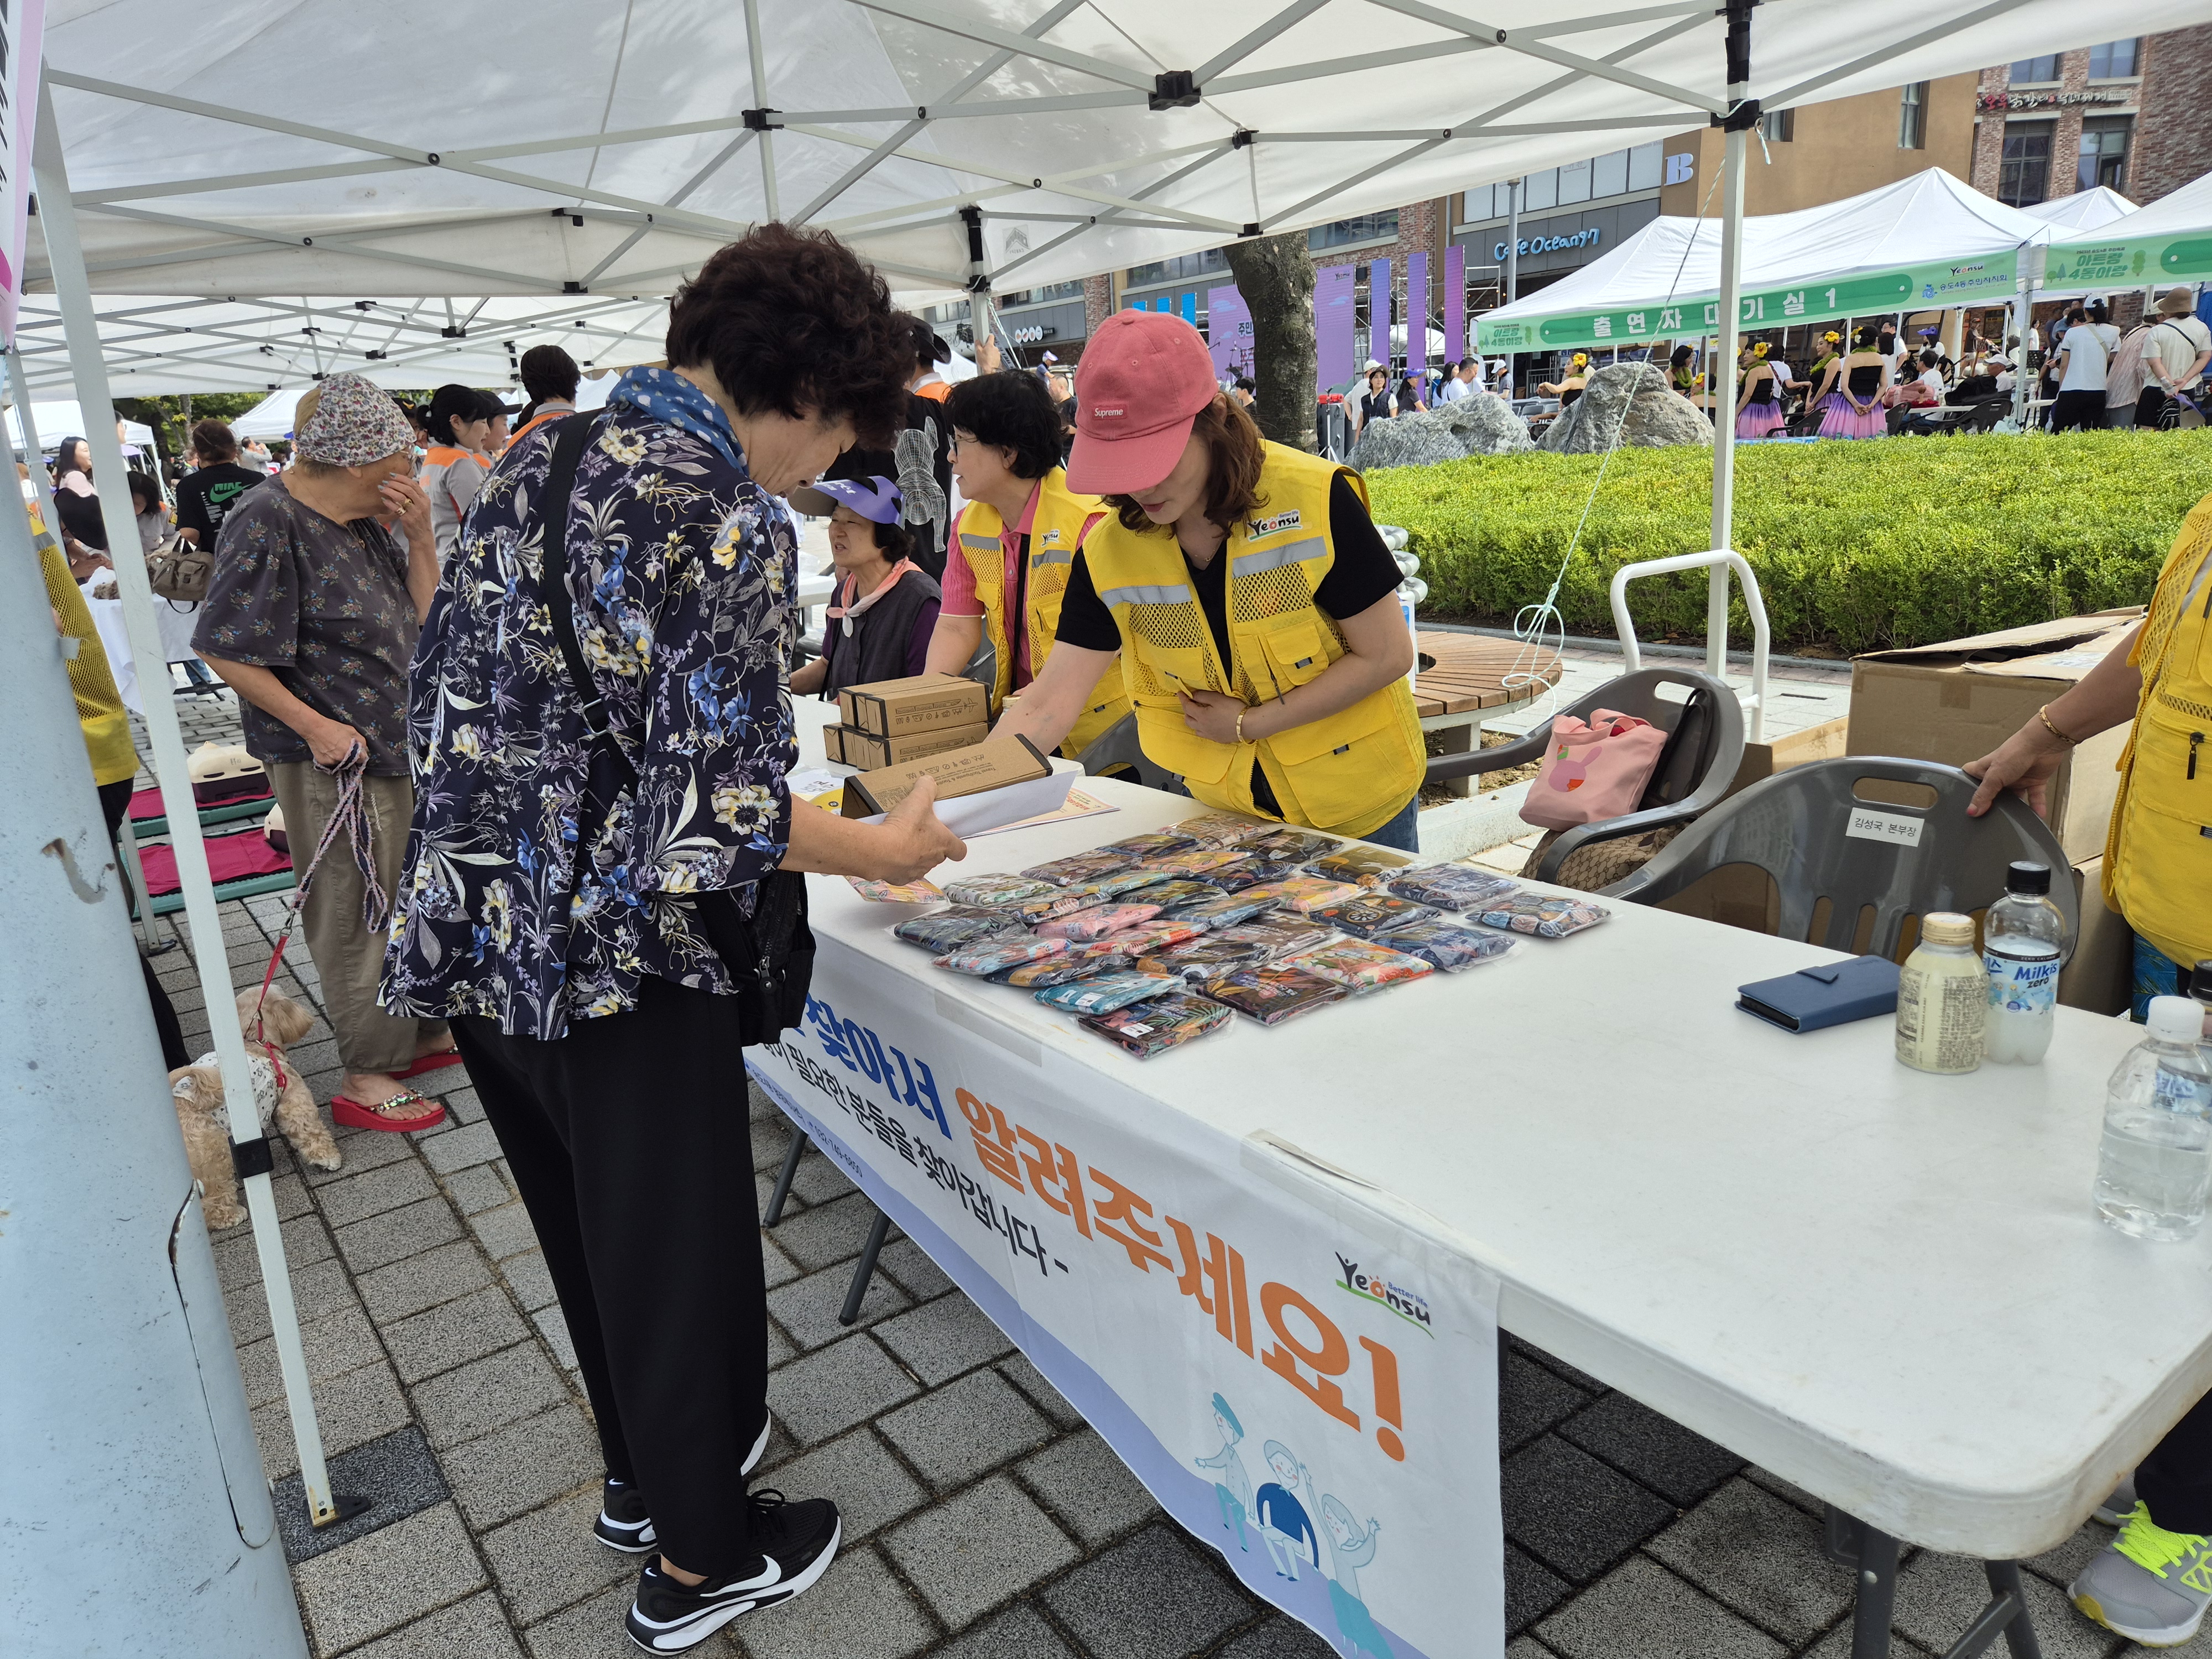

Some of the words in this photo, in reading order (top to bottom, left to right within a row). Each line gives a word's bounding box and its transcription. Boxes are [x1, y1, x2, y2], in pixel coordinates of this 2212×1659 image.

[1664, 153, 1693, 186] B
[2077, 252, 2123, 267] 아트랑
[1950, 265, 1984, 276] Yeonsu
[2068, 264, 2128, 280] 4동이랑
[1825, 288, 1835, 307] 1
[1094, 408, 1123, 419] Supreme
[215, 482, 242, 491] NIKE
[1248, 515, 1299, 536] Yeonsu
[1855, 817, 1883, 831] 김성국
[1888, 823, 1917, 837] 본부장
[2013, 963, 2058, 980] Milkis
[2027, 977, 2049, 989] zero
[786, 1042, 851, 1116] 필요한
[846, 1084, 918, 1168] 분들을
[955, 1087, 1405, 1462] 알려주세요!
[1335, 1251, 1431, 1326] Yeonsu
[1388, 1281, 1414, 1300] Better
[1415, 1295, 1428, 1308] life
